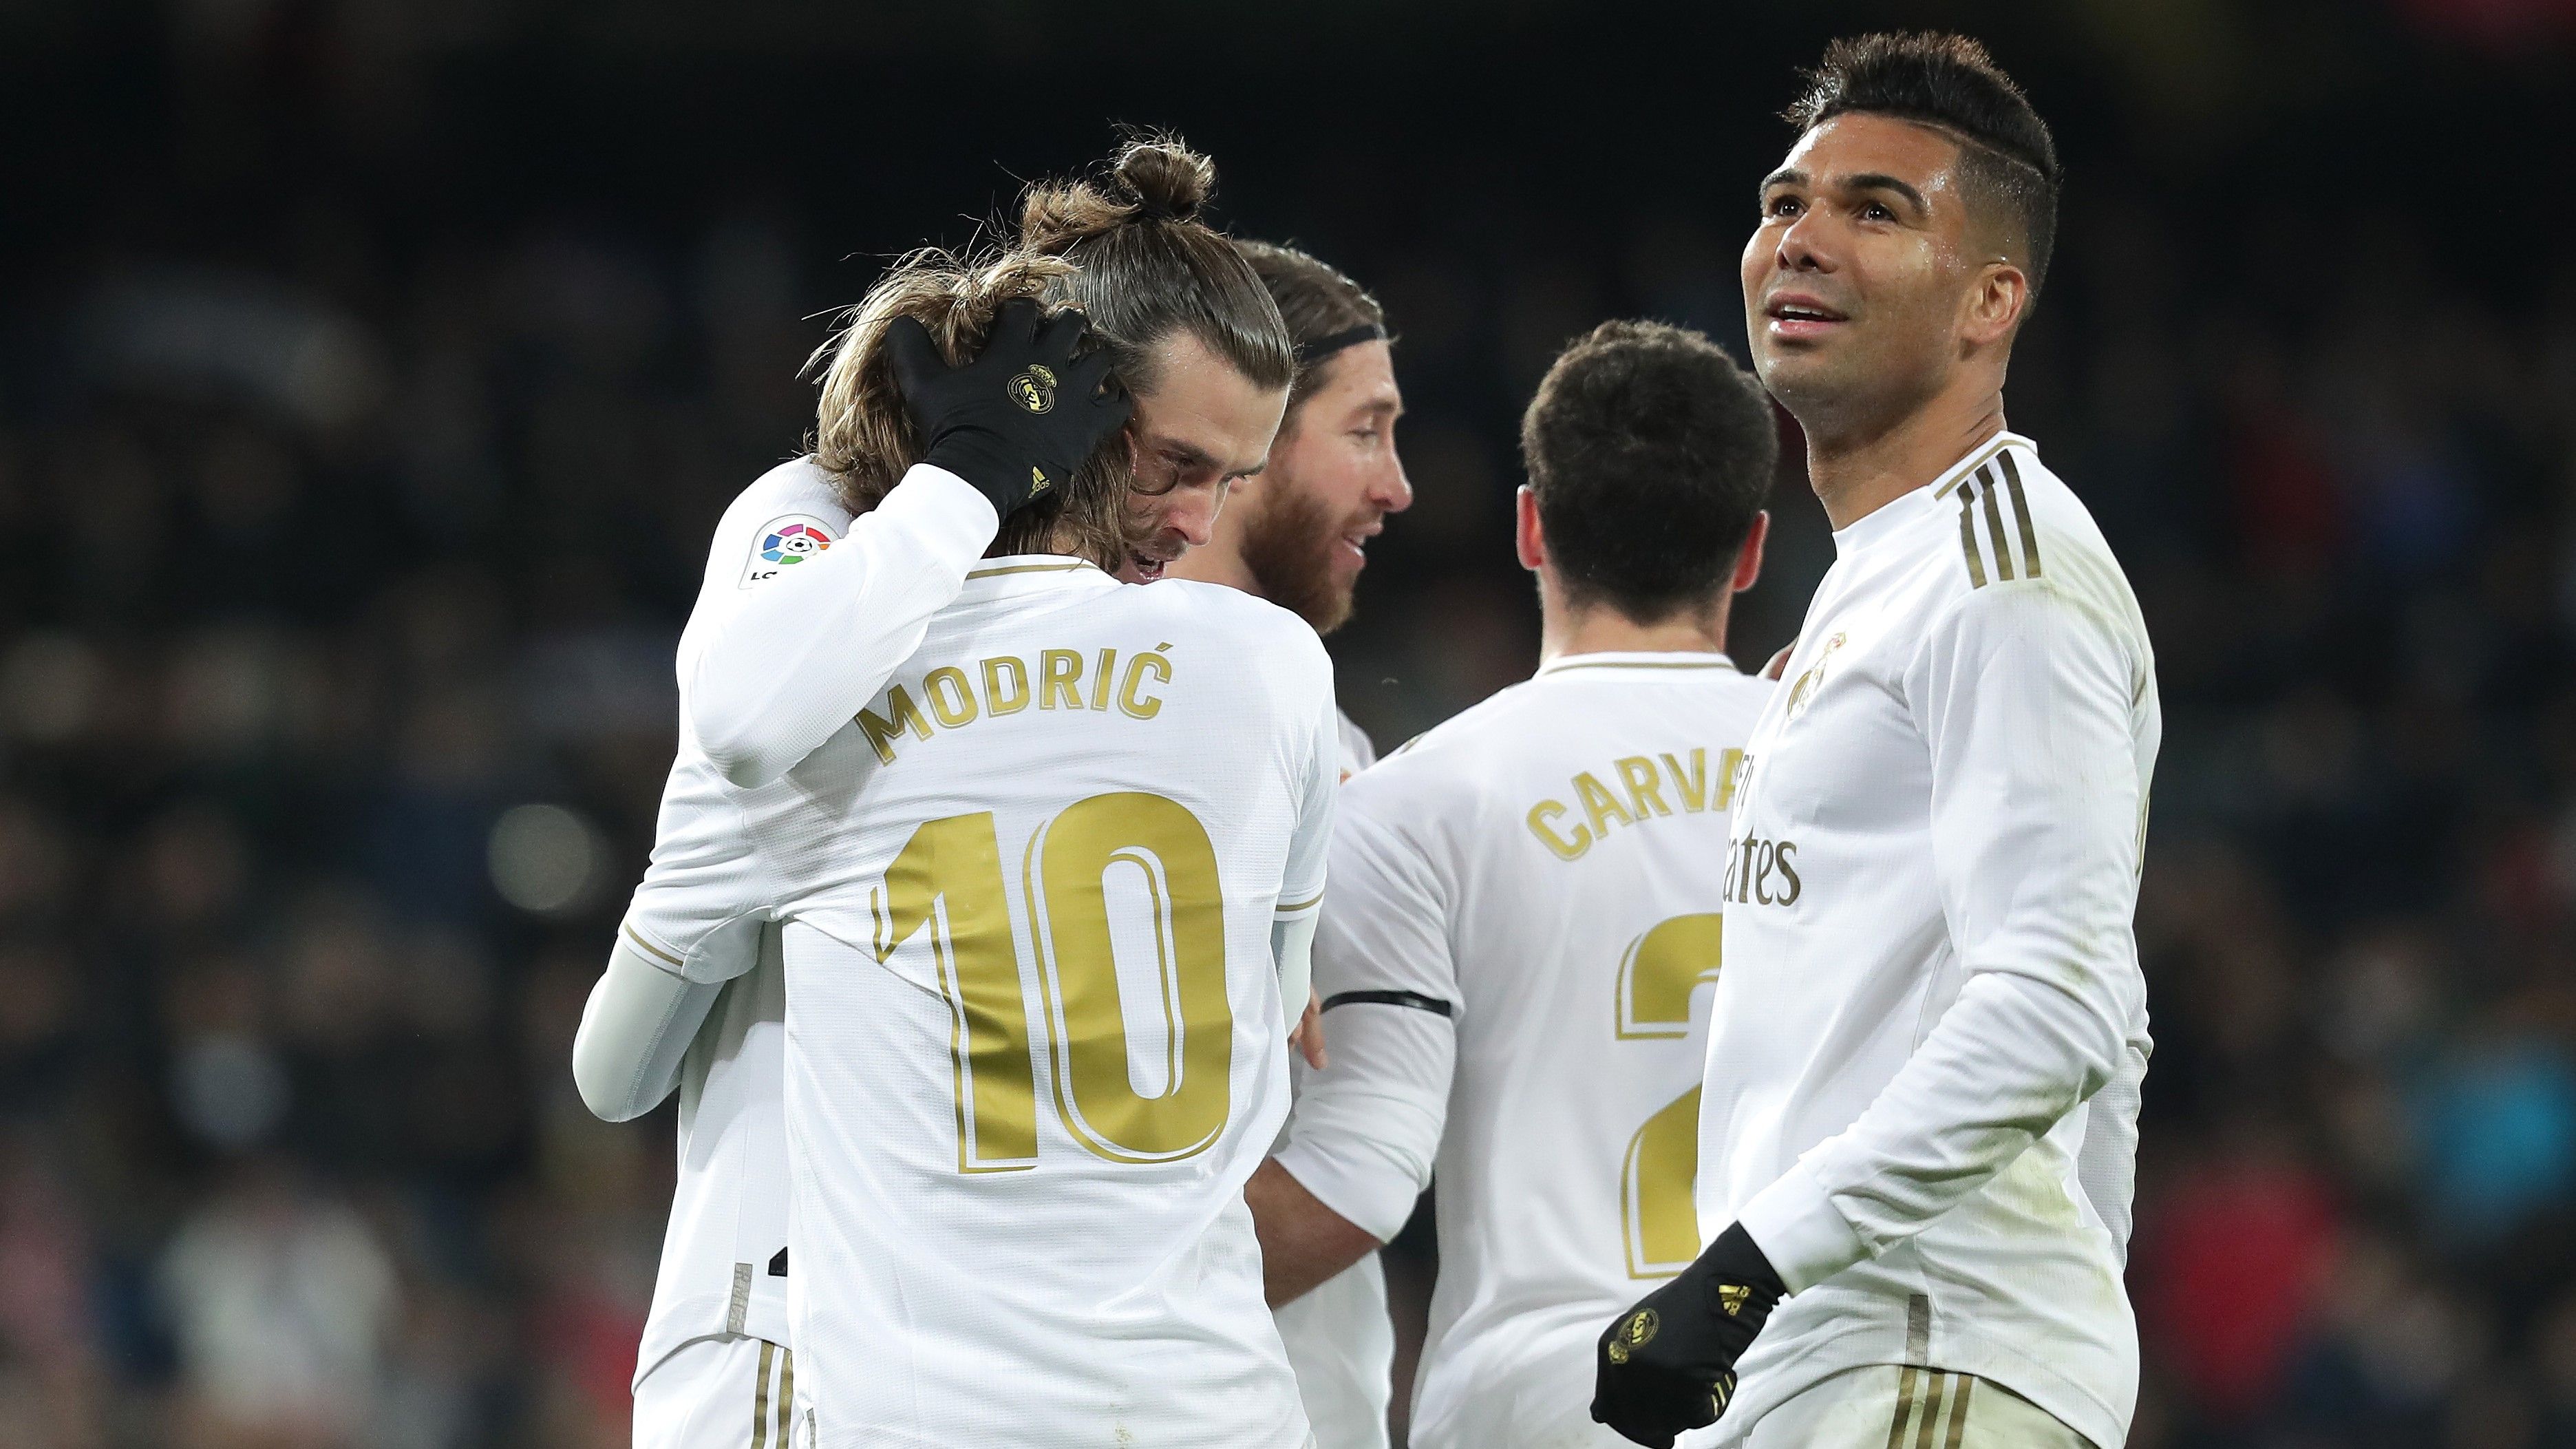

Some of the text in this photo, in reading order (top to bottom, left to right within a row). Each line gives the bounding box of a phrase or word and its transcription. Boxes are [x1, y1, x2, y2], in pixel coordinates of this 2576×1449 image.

[855, 642, 1173, 766] MODRIĆ
[871, 792, 1233, 1174] 10
[1723, 825, 1801, 907] ates
[1615, 913, 1723, 1280] 2
